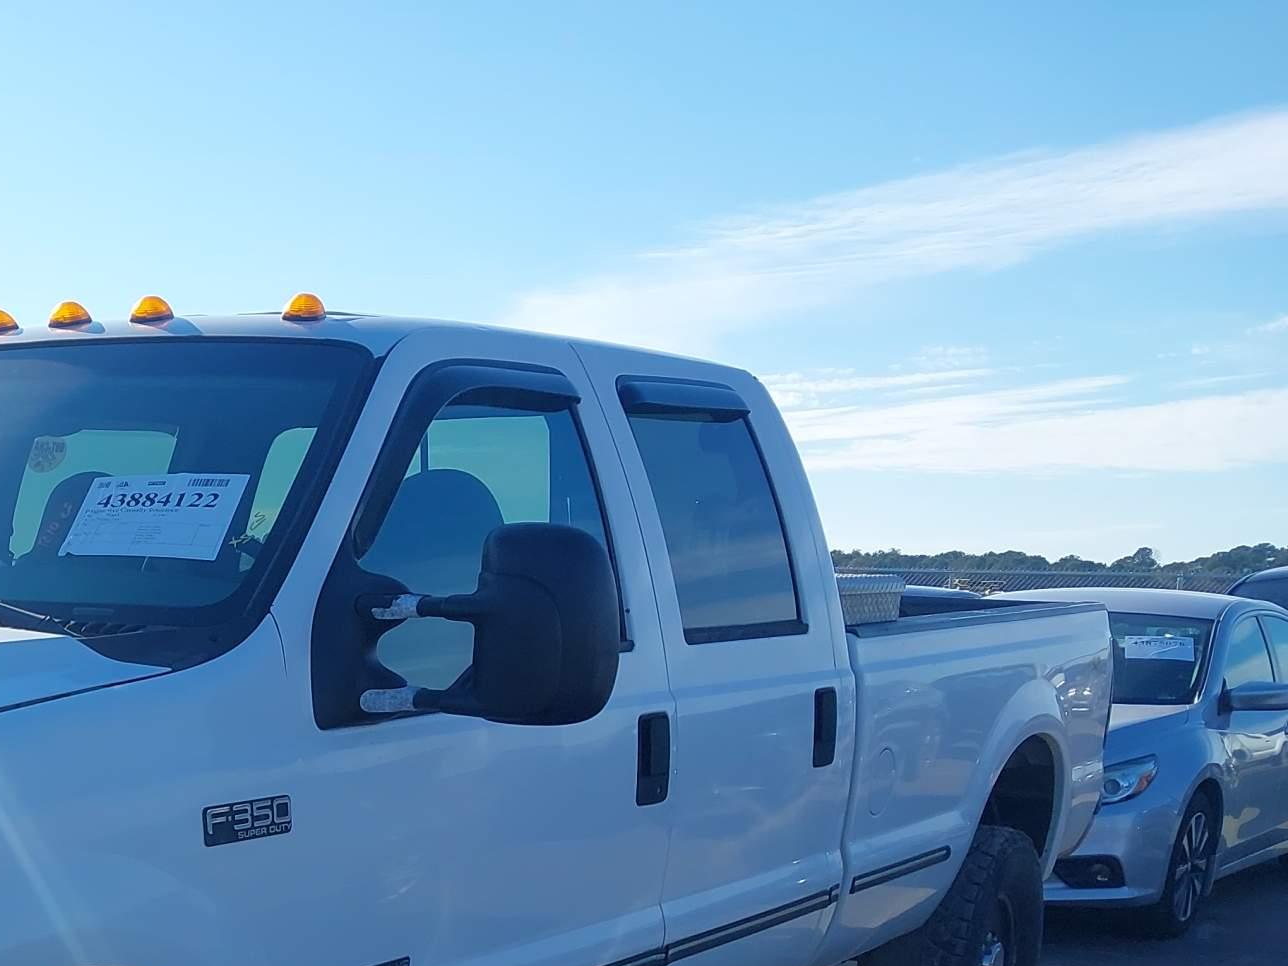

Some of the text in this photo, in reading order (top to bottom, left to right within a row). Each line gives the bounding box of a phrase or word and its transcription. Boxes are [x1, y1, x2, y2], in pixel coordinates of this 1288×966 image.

[97, 492, 221, 509] 43884122
[237, 823, 292, 839] SUPER DUTY
